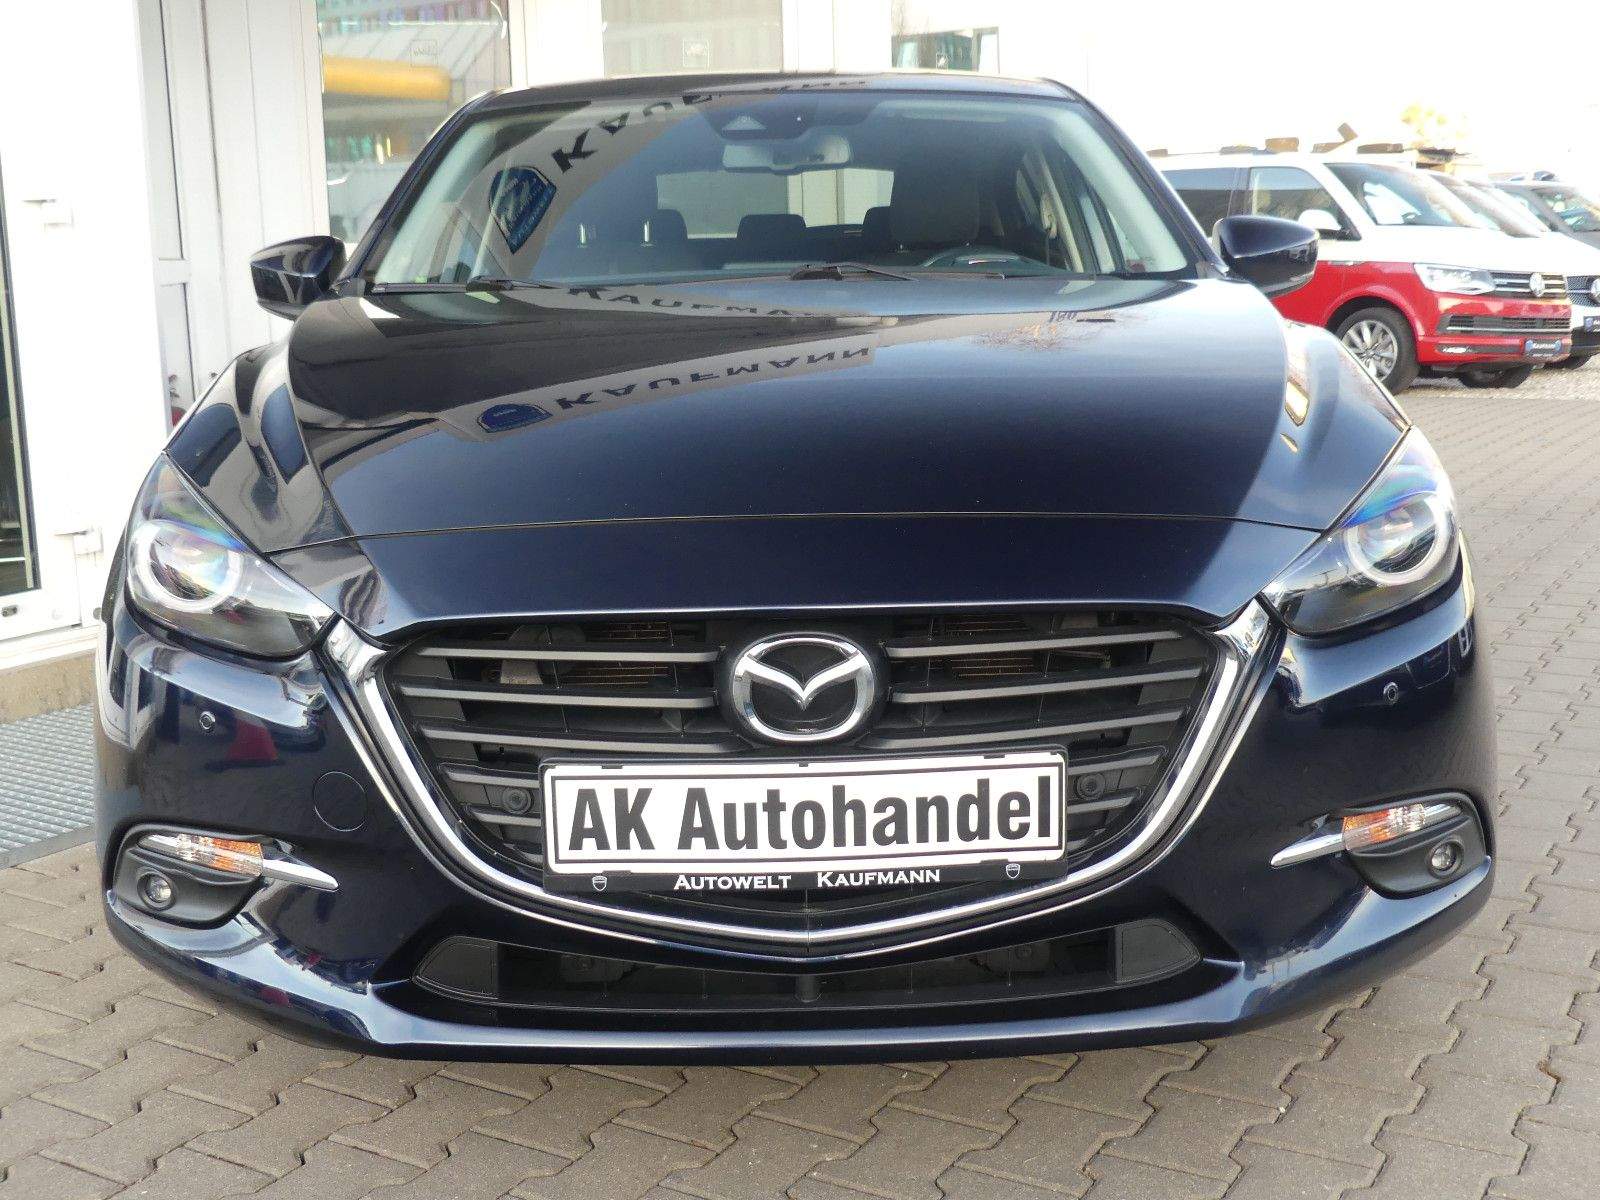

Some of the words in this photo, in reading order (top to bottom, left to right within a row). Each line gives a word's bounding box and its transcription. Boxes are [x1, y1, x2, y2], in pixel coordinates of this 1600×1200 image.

[568, 786, 654, 851] AK
[677, 775, 1051, 850] Autohandel
[673, 874, 791, 890] AUTOWELT
[817, 869, 942, 888] KAUFMANN
